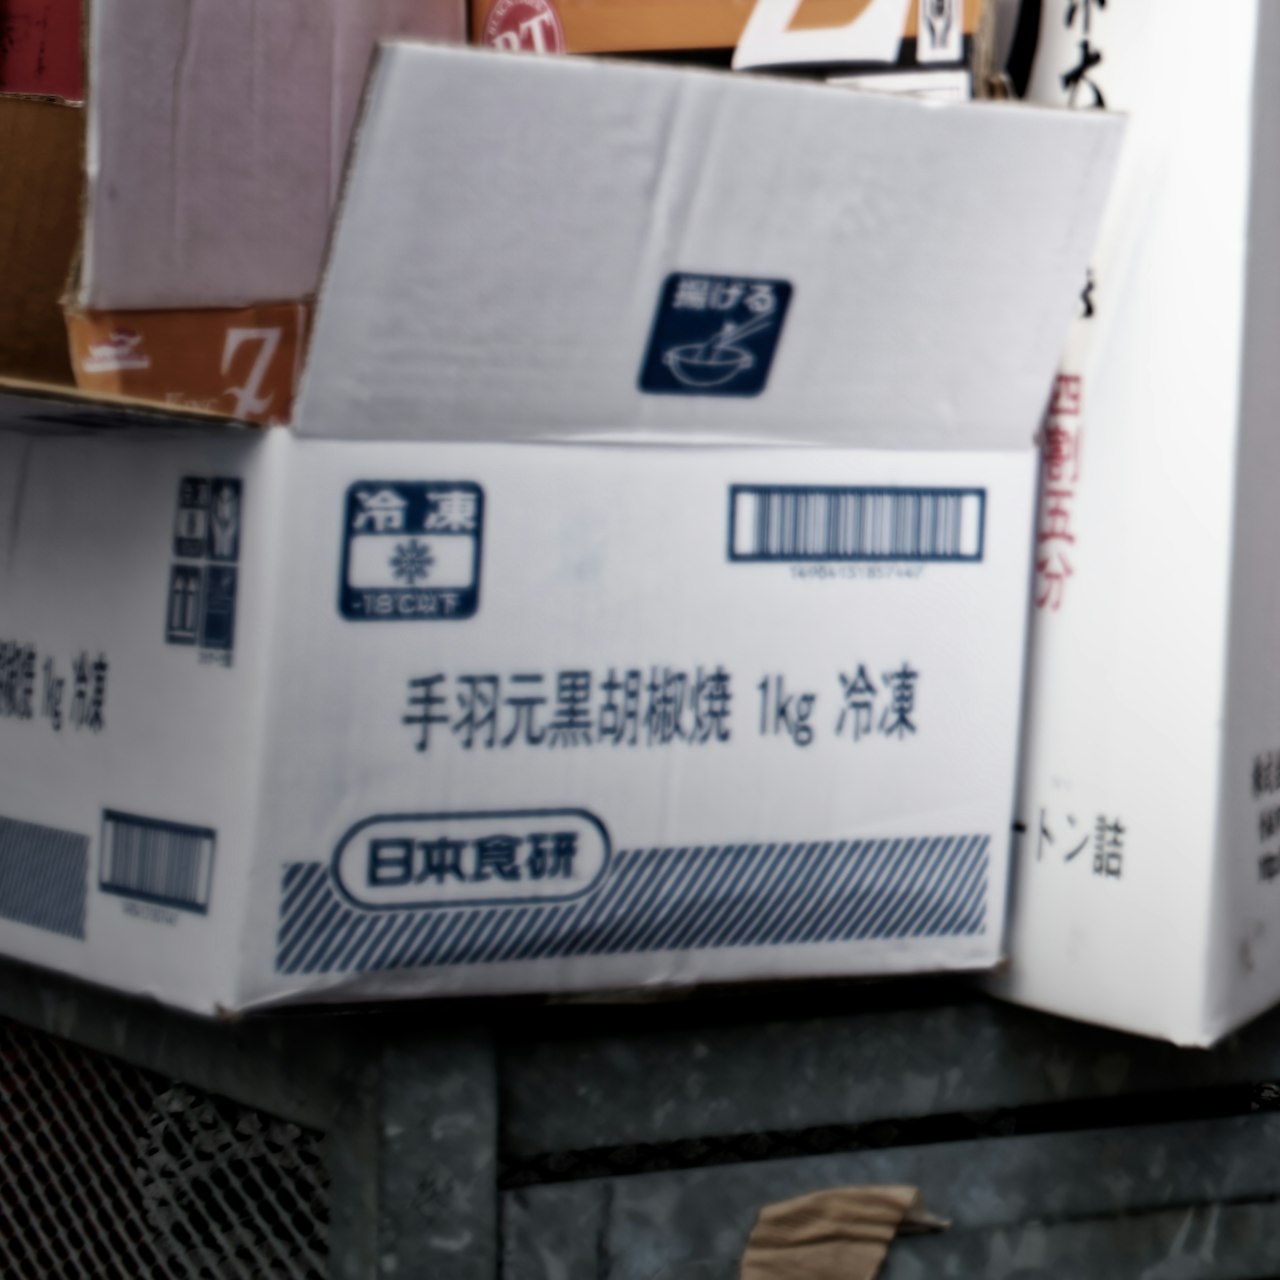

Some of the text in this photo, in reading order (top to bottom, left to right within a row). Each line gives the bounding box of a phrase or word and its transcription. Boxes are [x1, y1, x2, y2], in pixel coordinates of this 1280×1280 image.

[672, 279, 777, 313] 揚げる
[353, 489, 480, 531] 冷凍
[403, 662, 920, 752] 手羽元黒胡椒焼 1kg 冷凍
[367, 831, 578, 887] 日本食研
